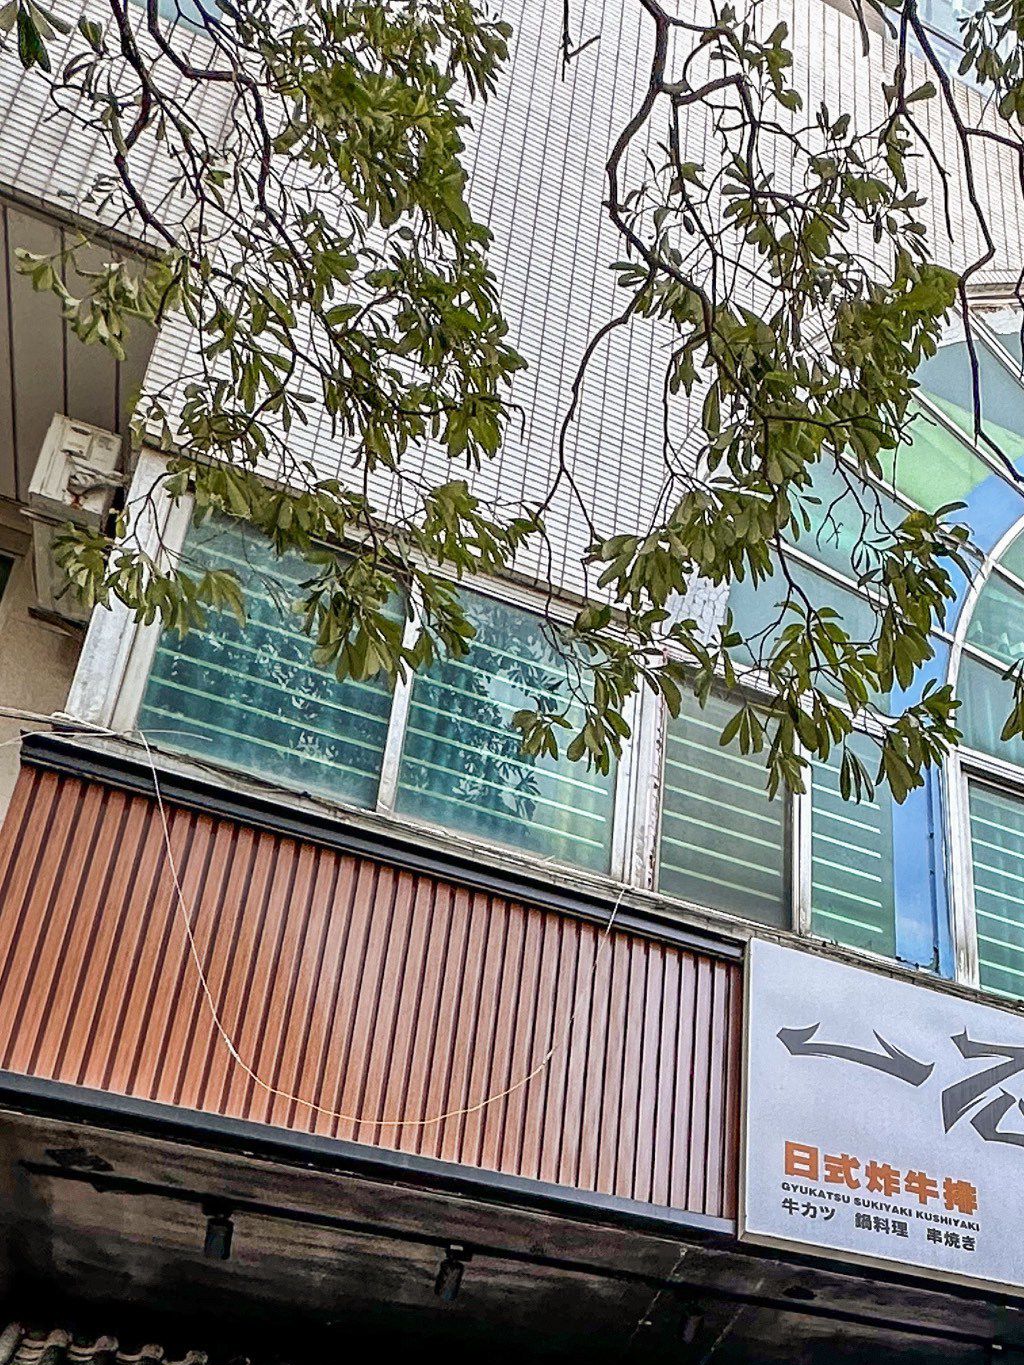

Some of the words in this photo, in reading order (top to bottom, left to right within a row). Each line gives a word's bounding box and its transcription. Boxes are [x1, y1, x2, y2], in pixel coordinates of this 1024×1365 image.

[784, 1140, 979, 1216] 日式炸牛排
[781, 1182, 851, 1204] GYUKATSU
[853, 1197, 913, 1217] SUKIYAKI
[915, 1210, 980, 1232] KUSHIYAKI
[781, 1197, 836, 1221] 牛カツ
[854, 1212, 909, 1238] 鍋料理
[926, 1227, 976, 1252] 串焼き
